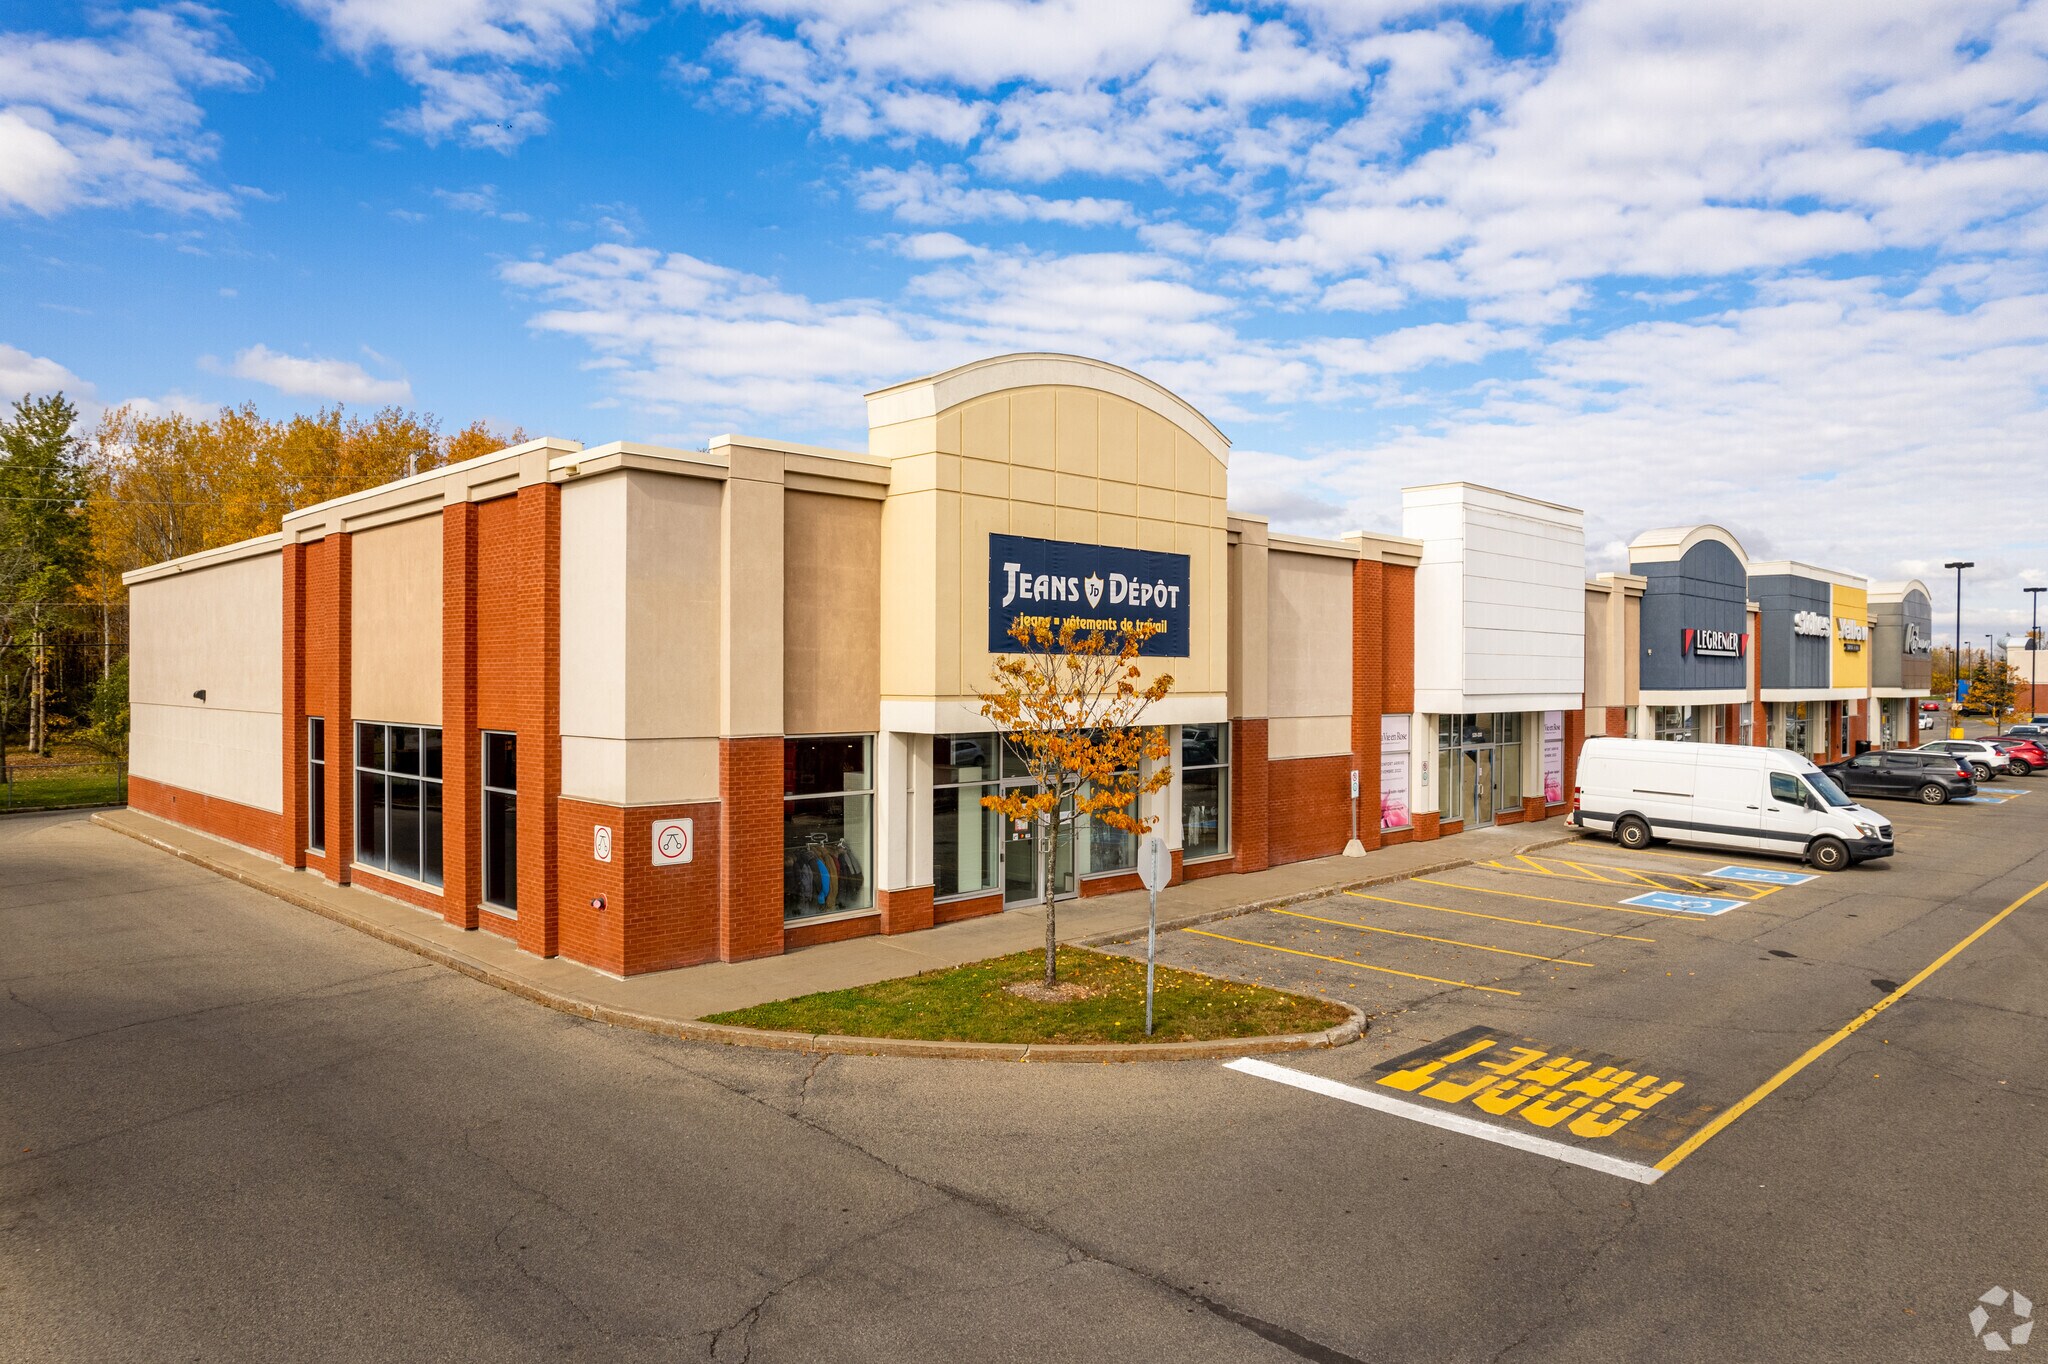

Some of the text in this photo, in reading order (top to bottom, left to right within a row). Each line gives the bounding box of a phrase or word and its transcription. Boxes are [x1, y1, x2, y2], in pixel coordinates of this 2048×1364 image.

[1003, 562, 1180, 609] JEANS DÉPÔT
[1120, 617, 1134, 633] de
